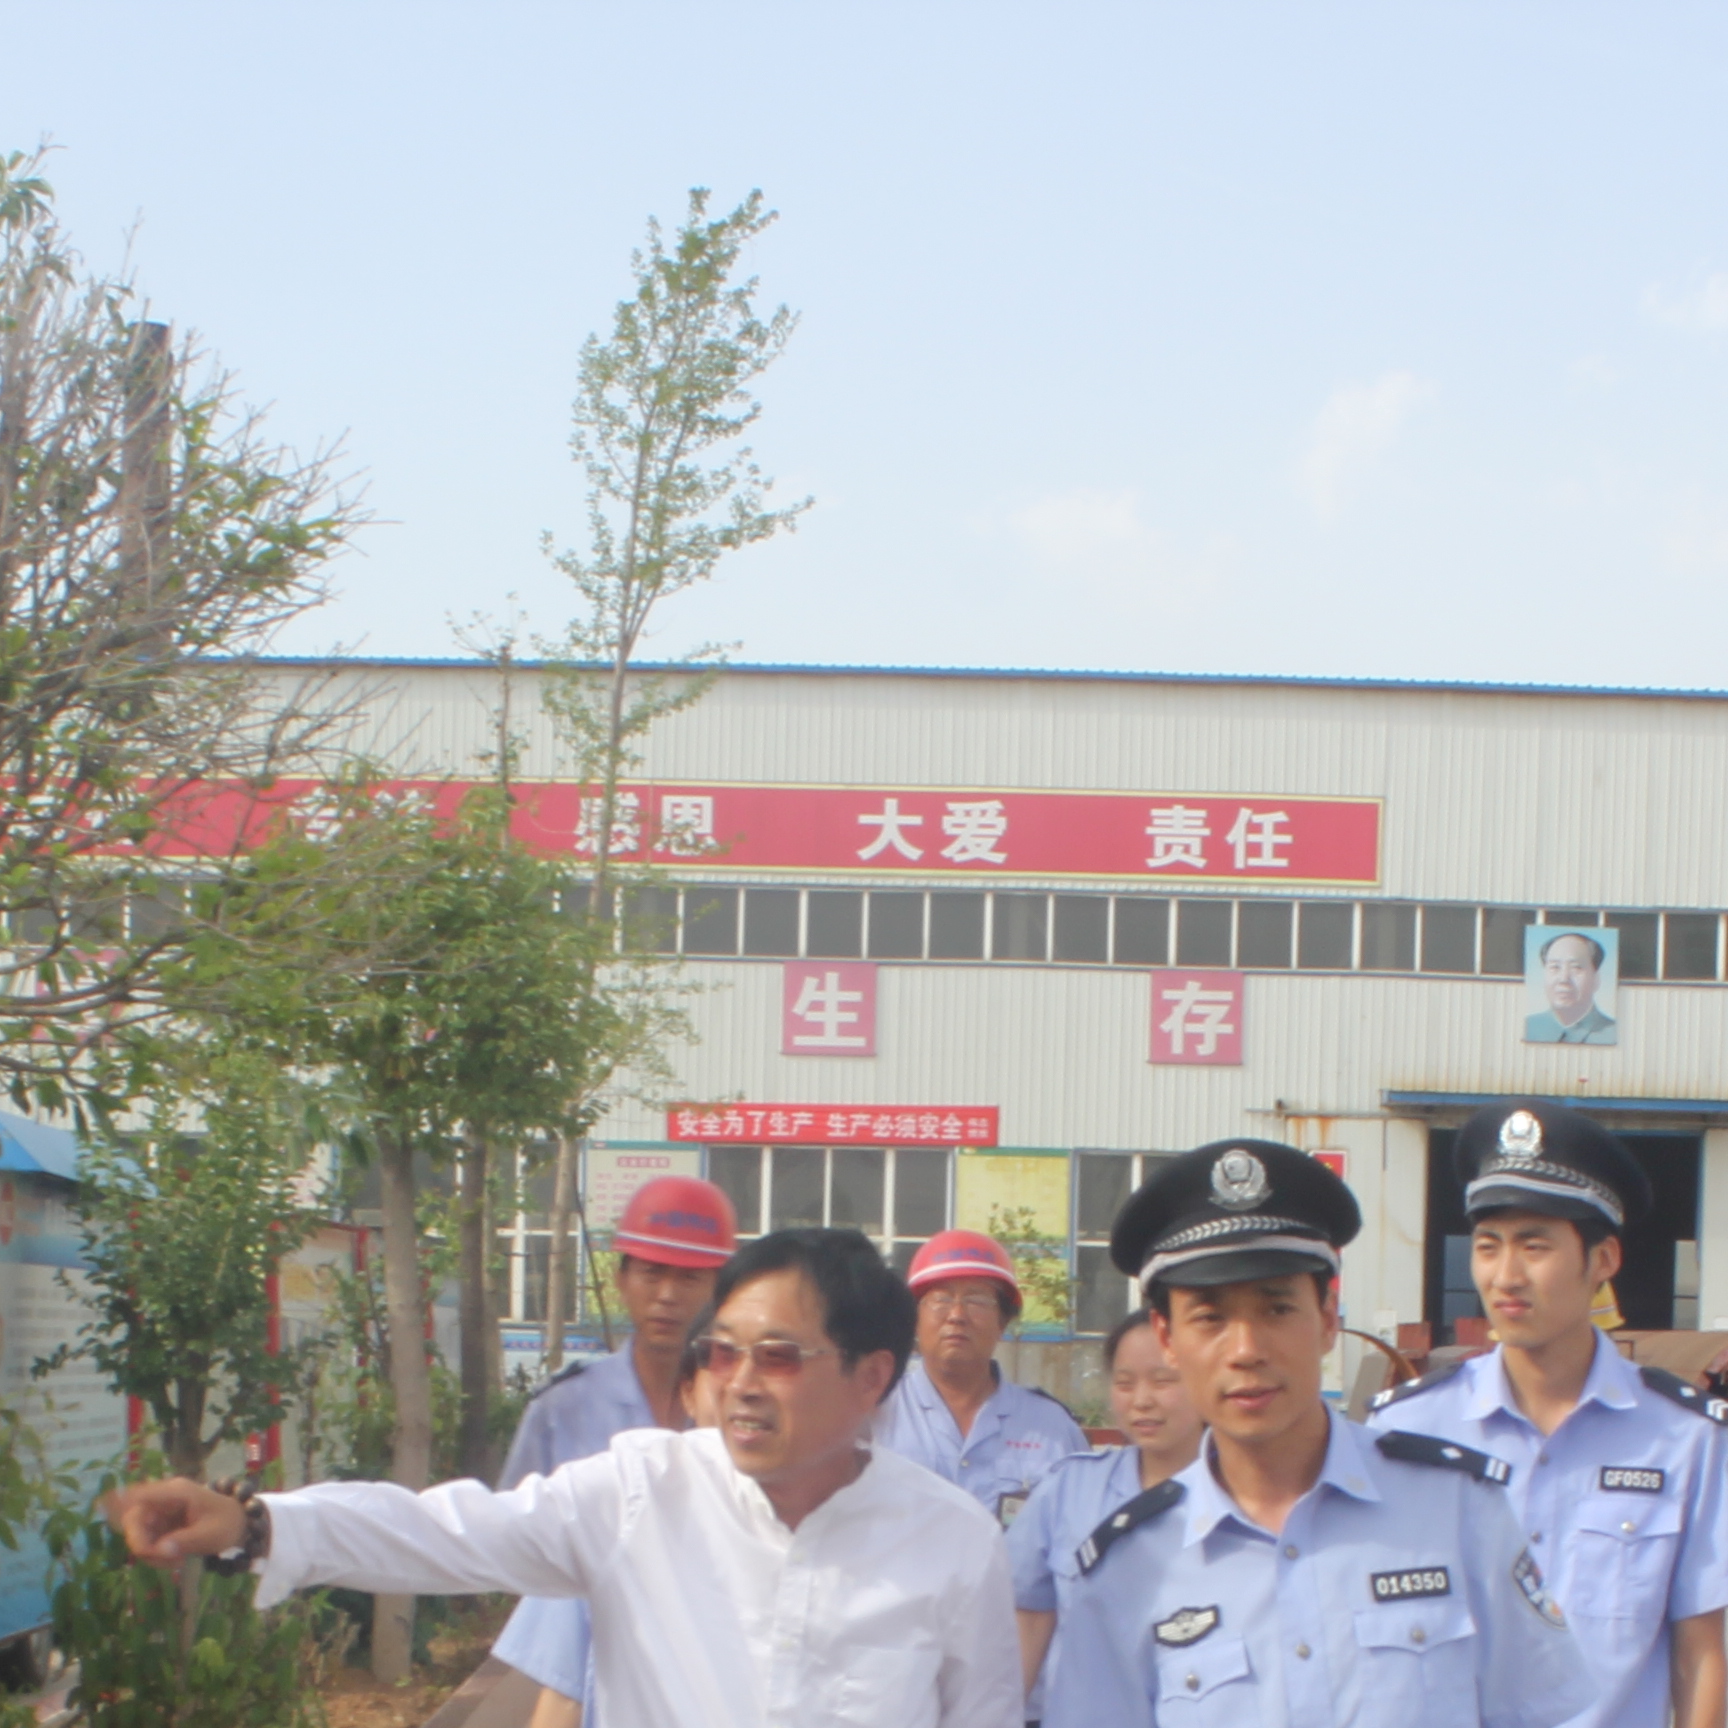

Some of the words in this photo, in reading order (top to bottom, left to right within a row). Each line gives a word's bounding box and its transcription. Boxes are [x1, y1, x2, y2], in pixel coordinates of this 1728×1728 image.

[574, 793, 720, 856] 感恩
[856, 798, 1011, 865] 大爱
[1144, 805, 1295, 870] 责任
[790, 971, 869, 1048] 生
[1158, 980, 1236, 1055] 存
[676, 1108, 815, 1138] 安全为了生产
[826, 1111, 964, 1141] 生产必须安全
[1375, 1570, 1448, 1598] 014350
